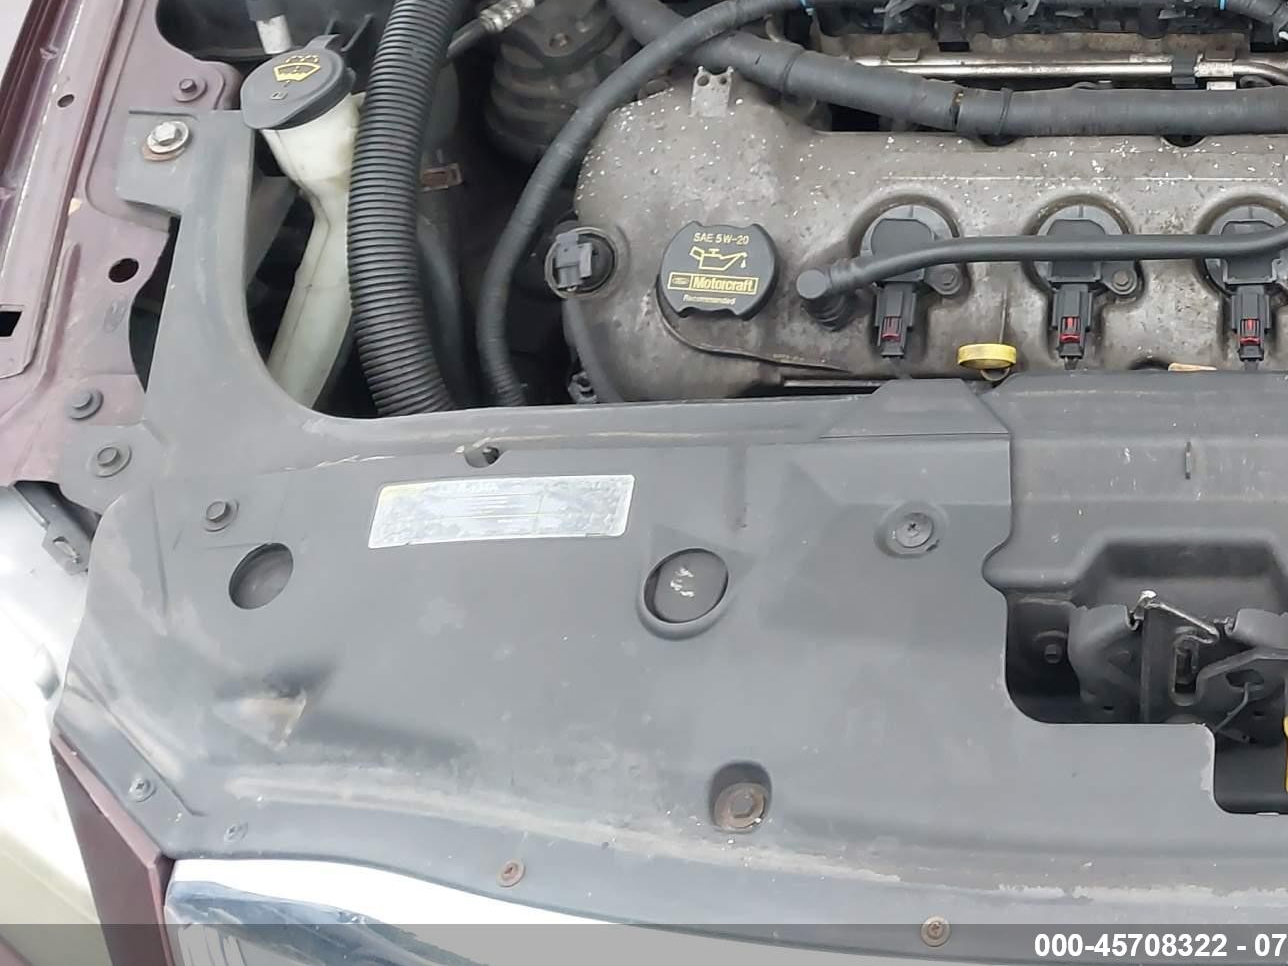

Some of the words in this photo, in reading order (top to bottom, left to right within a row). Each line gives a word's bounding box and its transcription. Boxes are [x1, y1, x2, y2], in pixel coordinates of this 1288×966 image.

[693, 232, 714, 243] SAE
[715, 233, 750, 245] 5W-20
[692, 276, 754, 292] Motorcraft
